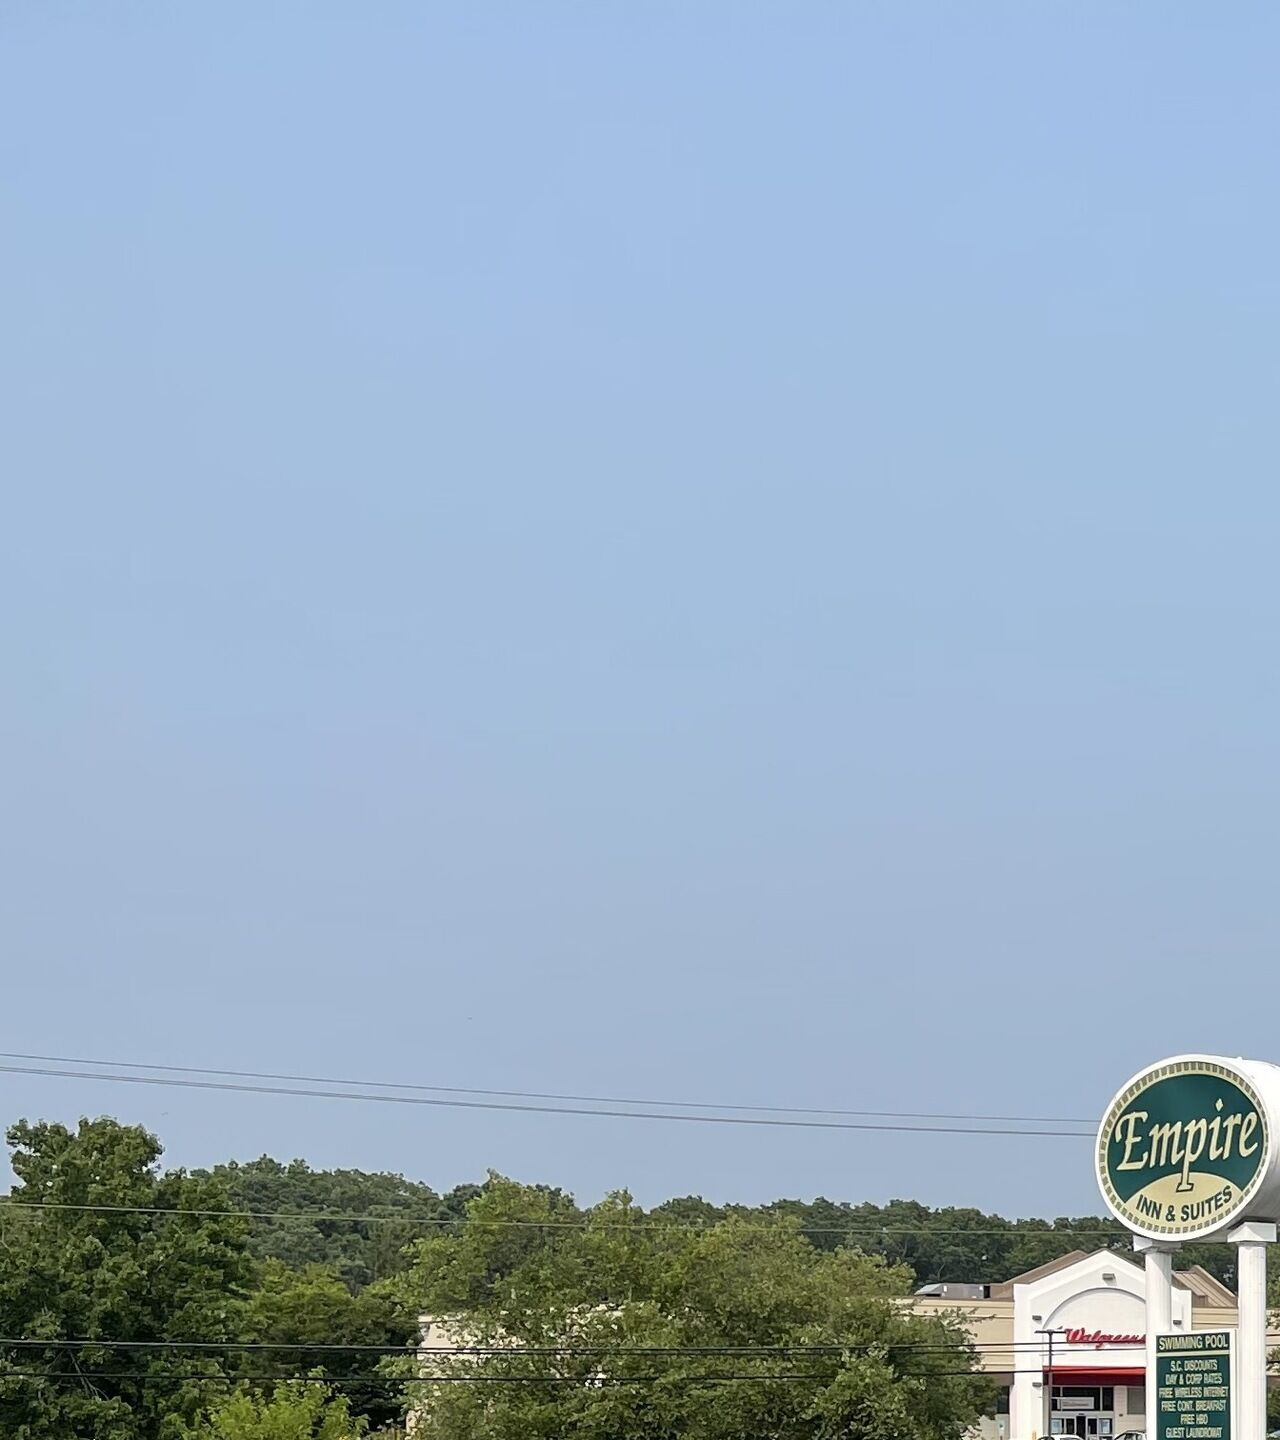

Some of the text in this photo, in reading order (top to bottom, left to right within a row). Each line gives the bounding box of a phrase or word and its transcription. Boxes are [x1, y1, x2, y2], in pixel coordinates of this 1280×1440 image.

[1114, 1098, 1258, 1192] Empire
[1136, 1184, 1233, 1222] INN & SUITES
[1159, 1334, 1228, 1350] SWIMMING POOL
[1170, 1359, 1217, 1371] S.C. DISCOUNTS
[1166, 1374, 1178, 1385] DAY
[1179, 1374, 1184, 1385] &
[1204, 1373, 1222, 1384] RATES
[1159, 1387, 1228, 1398] FREE WIRELESS INTERNET
[1161, 1401, 1176, 1412] FREE
[1196, 1400, 1226, 1411] BREAKFAST
[1180, 1414, 1208, 1424] FREE HBO
[1166, 1427, 1222, 1438] GUEST LAUNDROMAT
